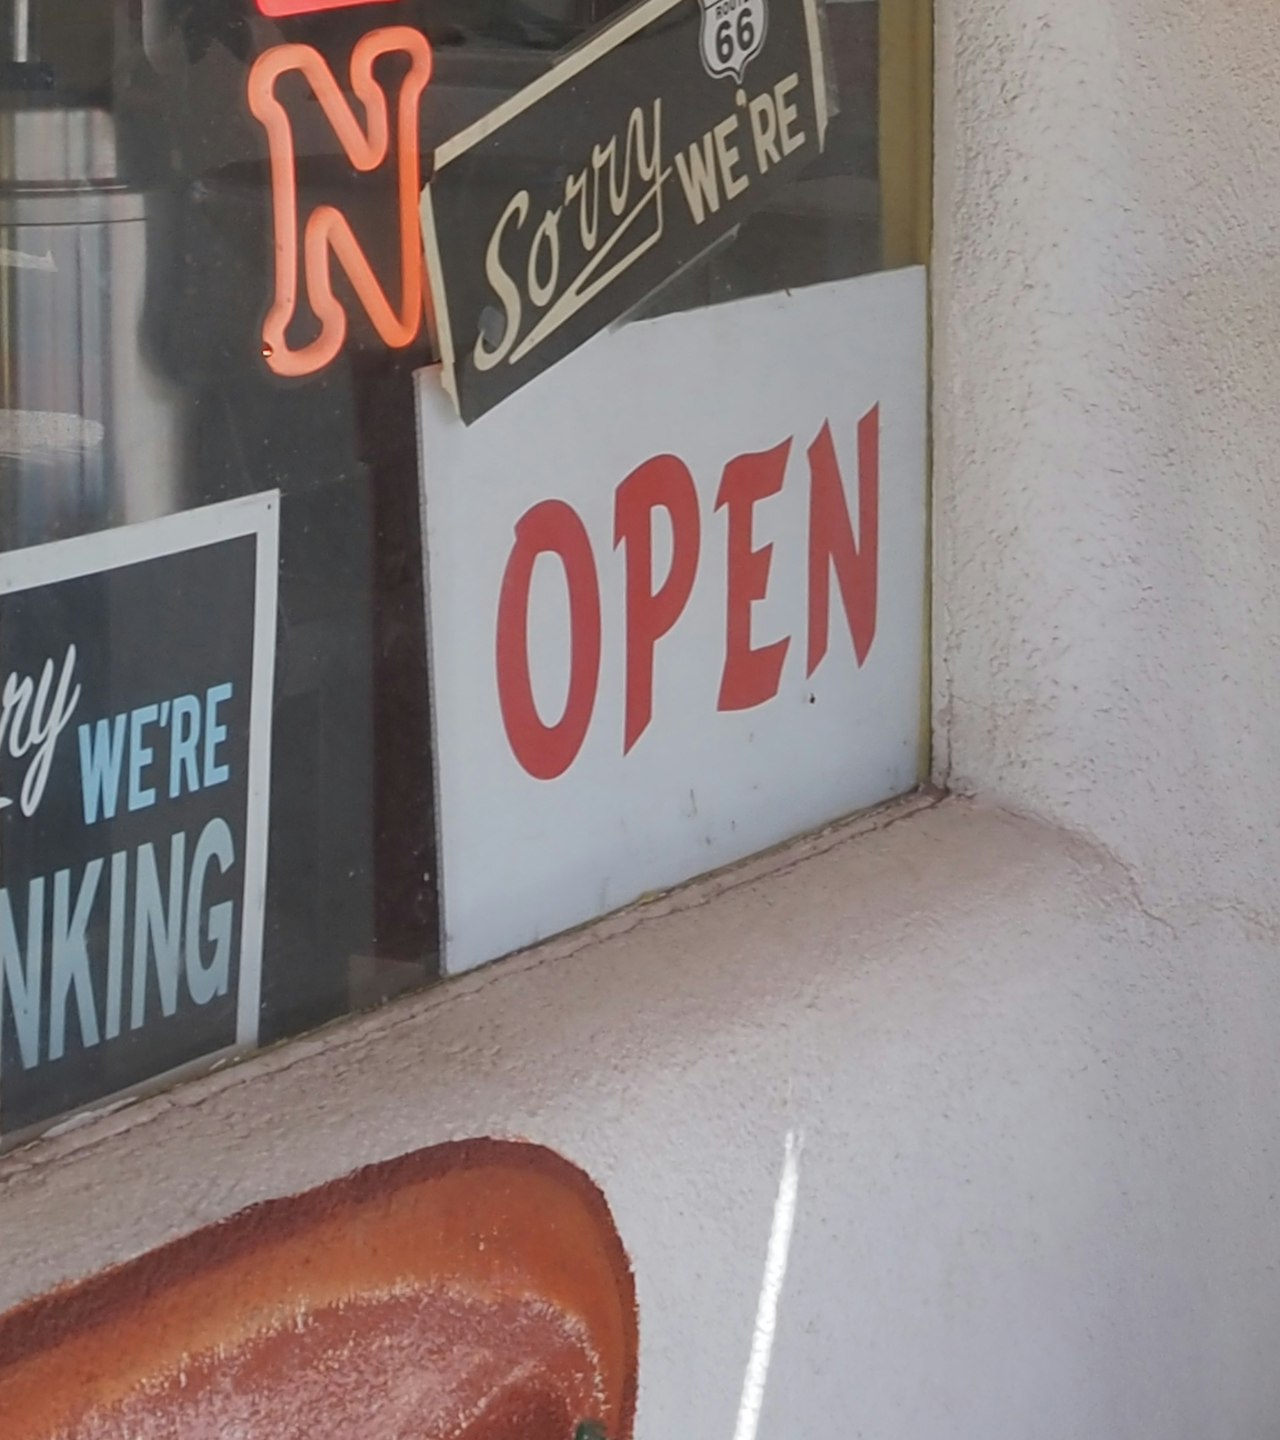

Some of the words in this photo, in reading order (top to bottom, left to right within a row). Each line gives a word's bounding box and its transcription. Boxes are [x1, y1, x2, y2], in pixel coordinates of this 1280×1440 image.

[714, 6, 756, 66] 66
[472, 97, 673, 373] Sorry
[674, 71, 806, 226] WE'RE
[495, 402, 881, 782] OPEN
[77, 681, 234, 826] WE'RE
